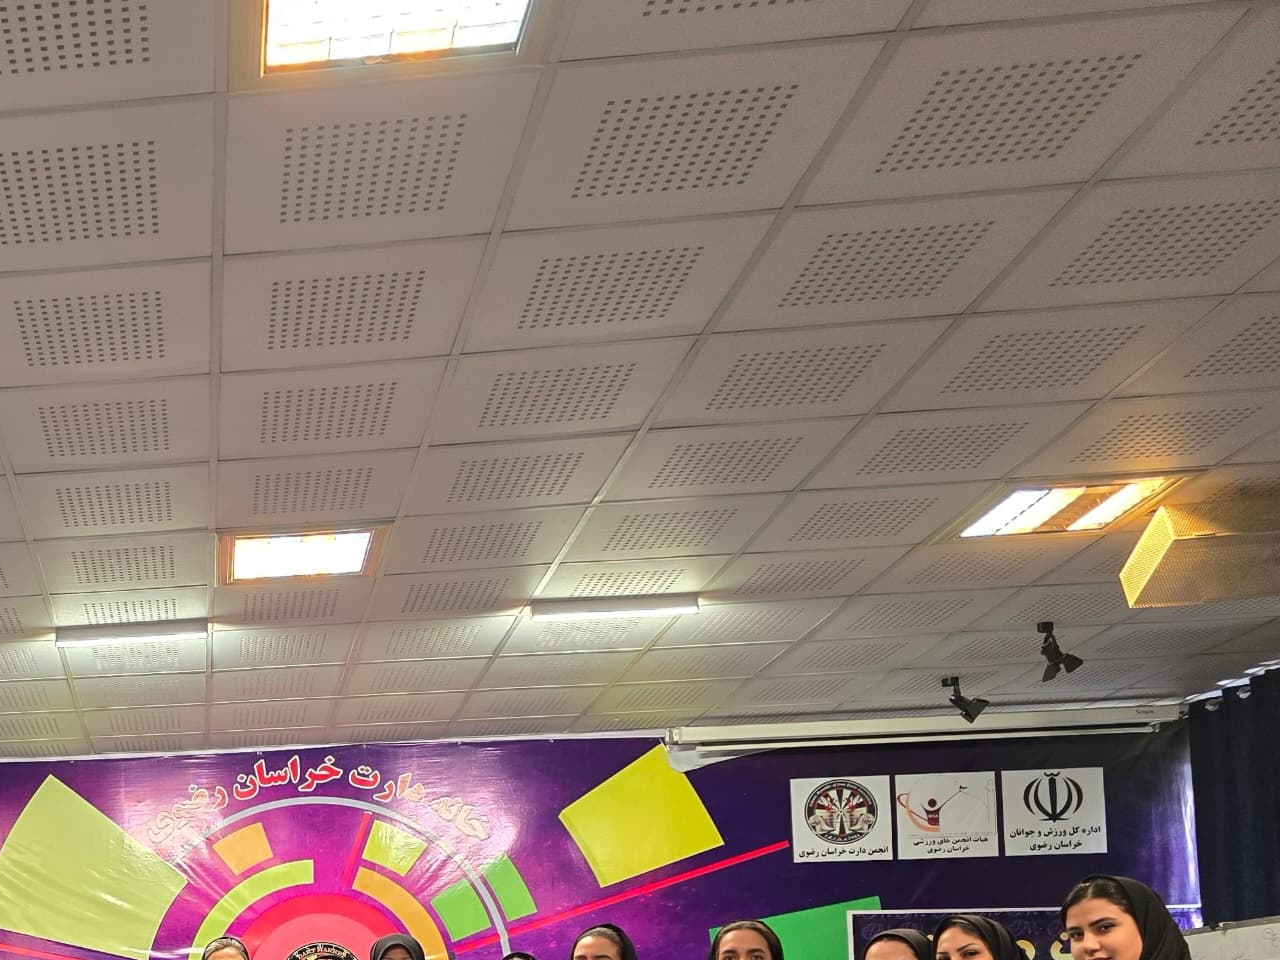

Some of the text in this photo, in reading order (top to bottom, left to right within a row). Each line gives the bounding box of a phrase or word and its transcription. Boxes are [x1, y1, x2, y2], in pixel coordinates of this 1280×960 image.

[233, 755, 343, 800] خراسان
[349, 765, 425, 802] دارت
[147, 785, 228, 844] رضوی
[1009, 828, 1035, 838] جوانان
[1043, 827, 1067, 837] ورزش
[1069, 826, 1080, 836] کل
[1082, 826, 1101, 836] اداره
[946, 845, 970, 853] خراسان
[1029, 840, 1082, 851] خراسان رضوی
[799, 846, 888, 858] انجمن دارت خراسان رضوی
